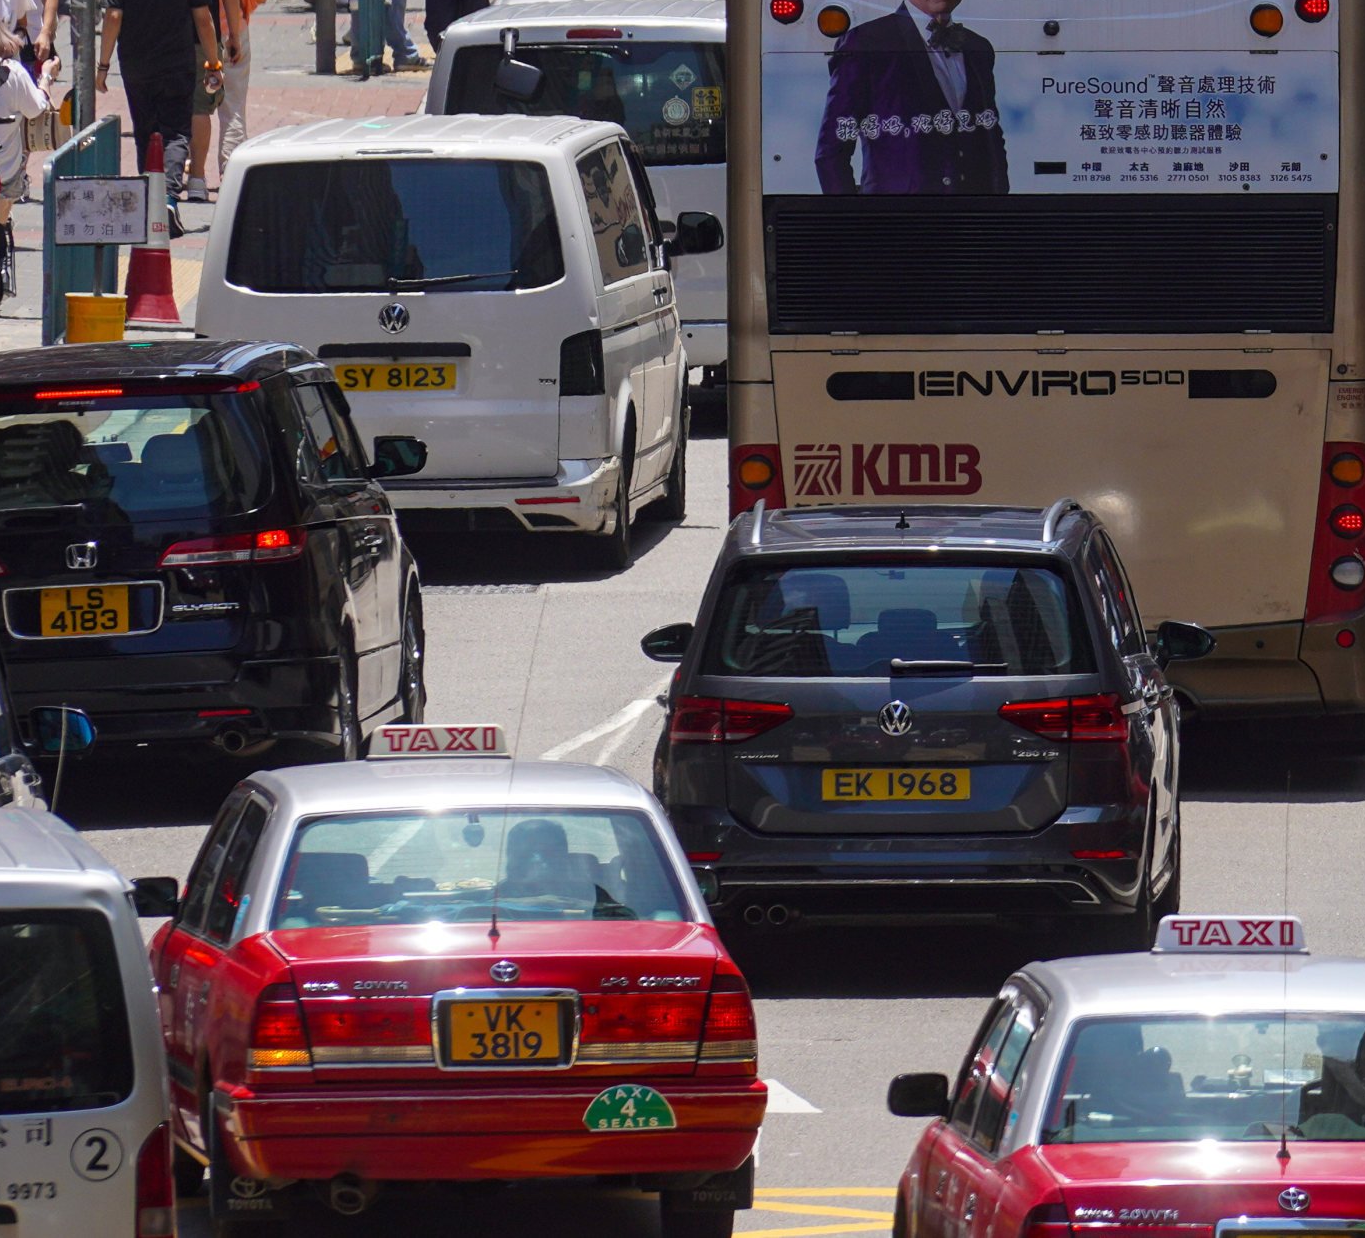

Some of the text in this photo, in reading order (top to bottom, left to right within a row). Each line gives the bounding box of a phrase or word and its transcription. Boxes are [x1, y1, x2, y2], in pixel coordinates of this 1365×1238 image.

[1041, 74, 1277, 95] PureSound 聲音處理技術
[1093, 98, 1227, 120] 聲音清晰自然
[1079, 123, 1243, 142] 極致零感助聽器體驗
[1072, 174, 1313, 182] 2111 8798 2116 5316 2771 0501 3105 8383 3126 5475
[1081, 162, 1302, 172] 中環 太古 油麻地 沙田 元朗
[62, 223, 134, 237] 請勿泊車
[343, 366, 447, 388] SY 8123
[918, 369, 1185, 397] ENVIRO 500
[851, 443, 983, 496] KMB
[65, 588, 105, 611] LS
[50, 608, 119, 633] 4183
[382, 726, 497, 752] TAXI
[834, 771, 958, 797] EK 1968
[1170, 920, 1294, 947] TAXI
[600, 976, 702, 988] LPG COMFORT
[482, 1004, 526, 1031] VK
[469, 1031, 543, 1060] 3819
[599, 1086, 653, 1106] TAXI
[620, 1097, 637, 1117] 4
[597, 1116, 660, 1129] SEATS
[84, 1134, 110, 1172] 2
[7, 1181, 58, 1200] 9973
